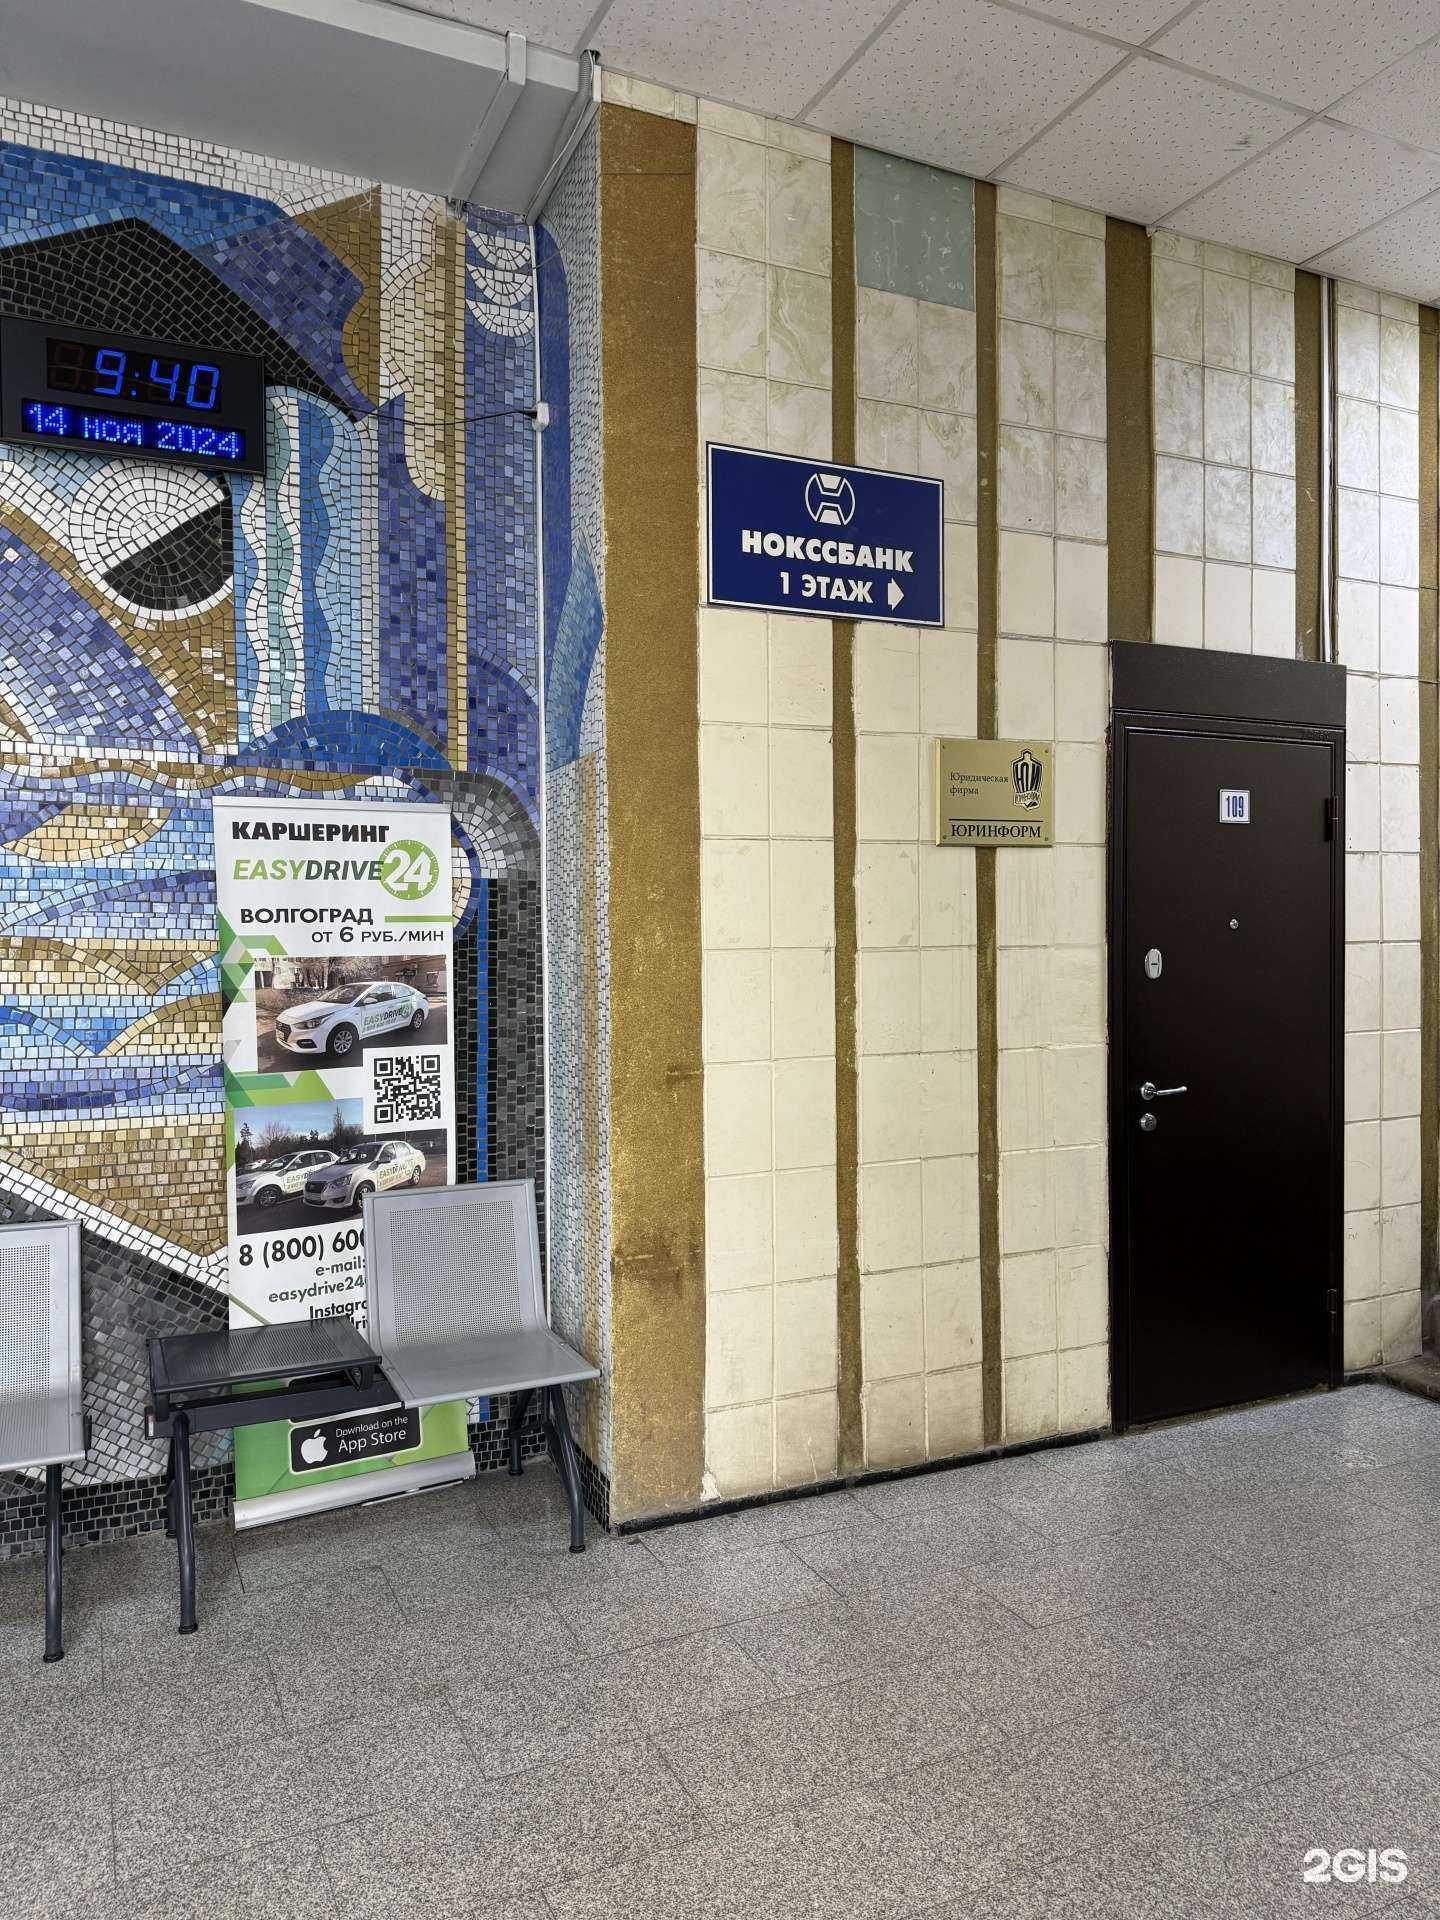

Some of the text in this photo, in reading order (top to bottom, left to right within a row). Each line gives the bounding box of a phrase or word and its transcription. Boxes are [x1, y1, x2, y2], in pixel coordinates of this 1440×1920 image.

[93, 348, 221, 410] 9:40
[29, 403, 68, 436] 14
[157, 421, 240, 459] 2024
[741, 529, 914, 573] НОКССБАНК
[779, 571, 874, 604] 1 ЭТАЖ
[949, 771, 1009, 785] Юридическая
[949, 784, 979, 796] фирма
[1225, 795, 1245, 818] 109
[232, 821, 390, 843] КАРШЕРИНГ
[951, 824, 1041, 838] ЮРИНФОРМ
[240, 907, 374, 926] ВОЛГОГРАД
[339, 926, 354, 943] 6
[239, 1244, 253, 1266] 8
[263, 1234, 324, 1268] (800)
[268, 1275, 367, 1303] easydrive24
[335, 1416, 408, 1437] Download on the
[338, 1429, 407, 1454] App Store
